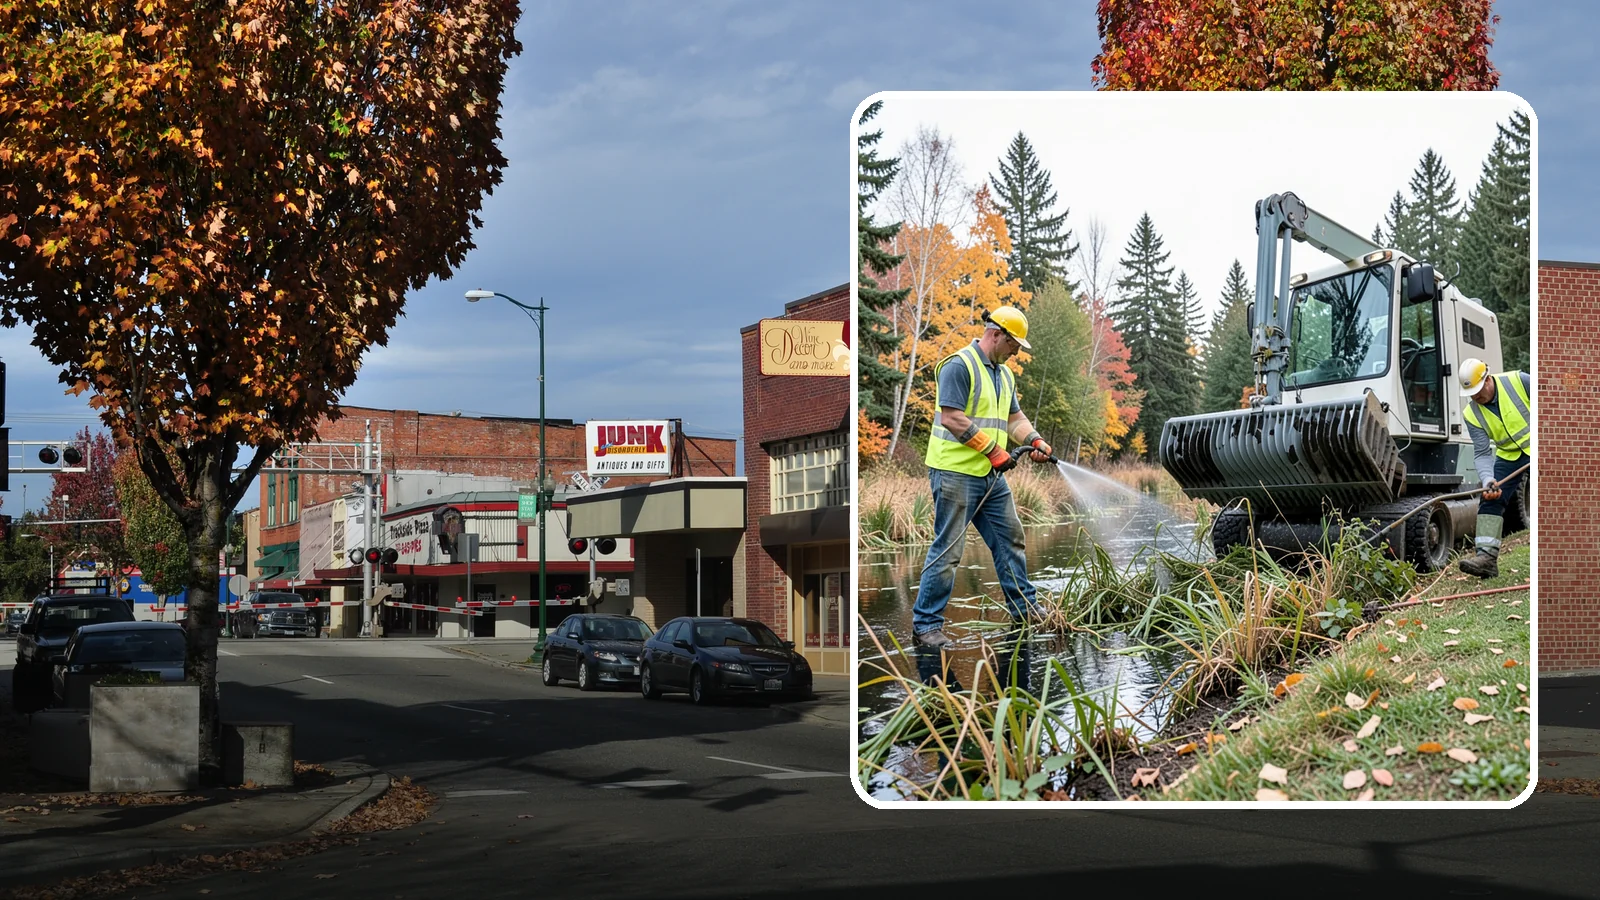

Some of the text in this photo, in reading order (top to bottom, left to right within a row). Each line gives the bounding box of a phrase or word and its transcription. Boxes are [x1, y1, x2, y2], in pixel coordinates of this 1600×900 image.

[596, 425, 665, 457] JUNK
[607, 446, 646, 454] DISORDERLY
[597, 461, 665, 470] ANTIQUES AND GIFTS
[573, 473, 589, 492] RAIL
[352, 498, 365, 511] CRO
[415, 519, 429, 535] Pizza
